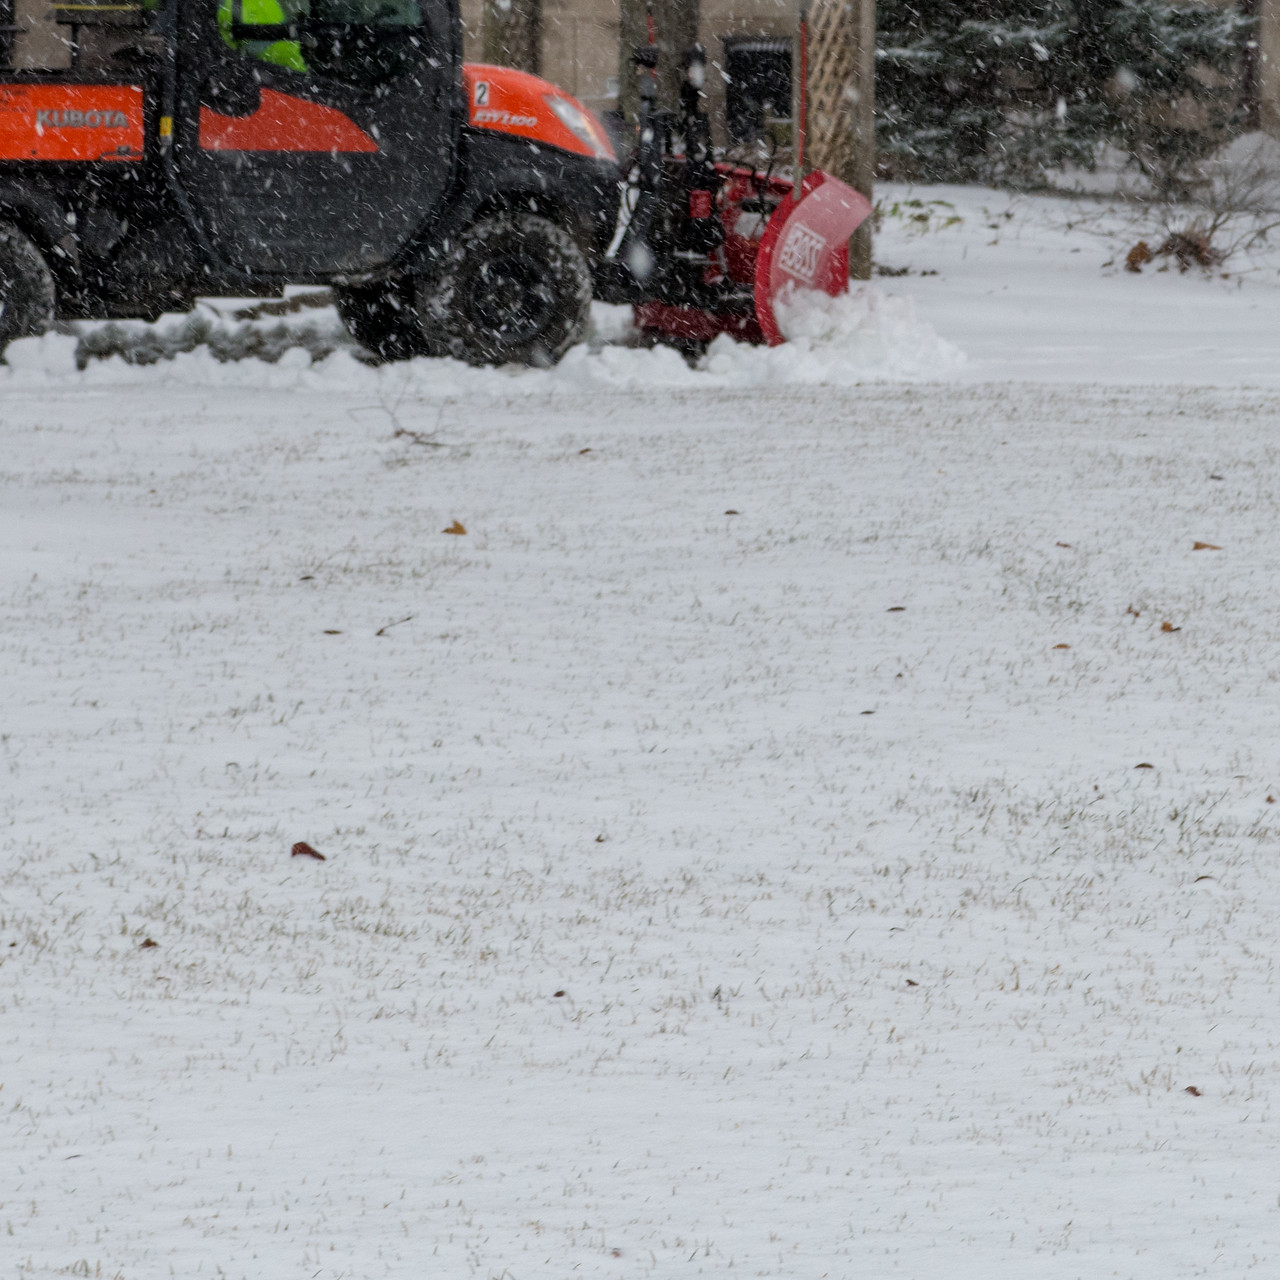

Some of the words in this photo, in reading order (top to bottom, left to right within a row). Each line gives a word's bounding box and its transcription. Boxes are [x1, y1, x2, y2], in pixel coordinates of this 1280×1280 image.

[476, 82, 488, 106] 2
[36, 109, 129, 128] KUBOTA
[785, 228, 823, 278] BOSS
